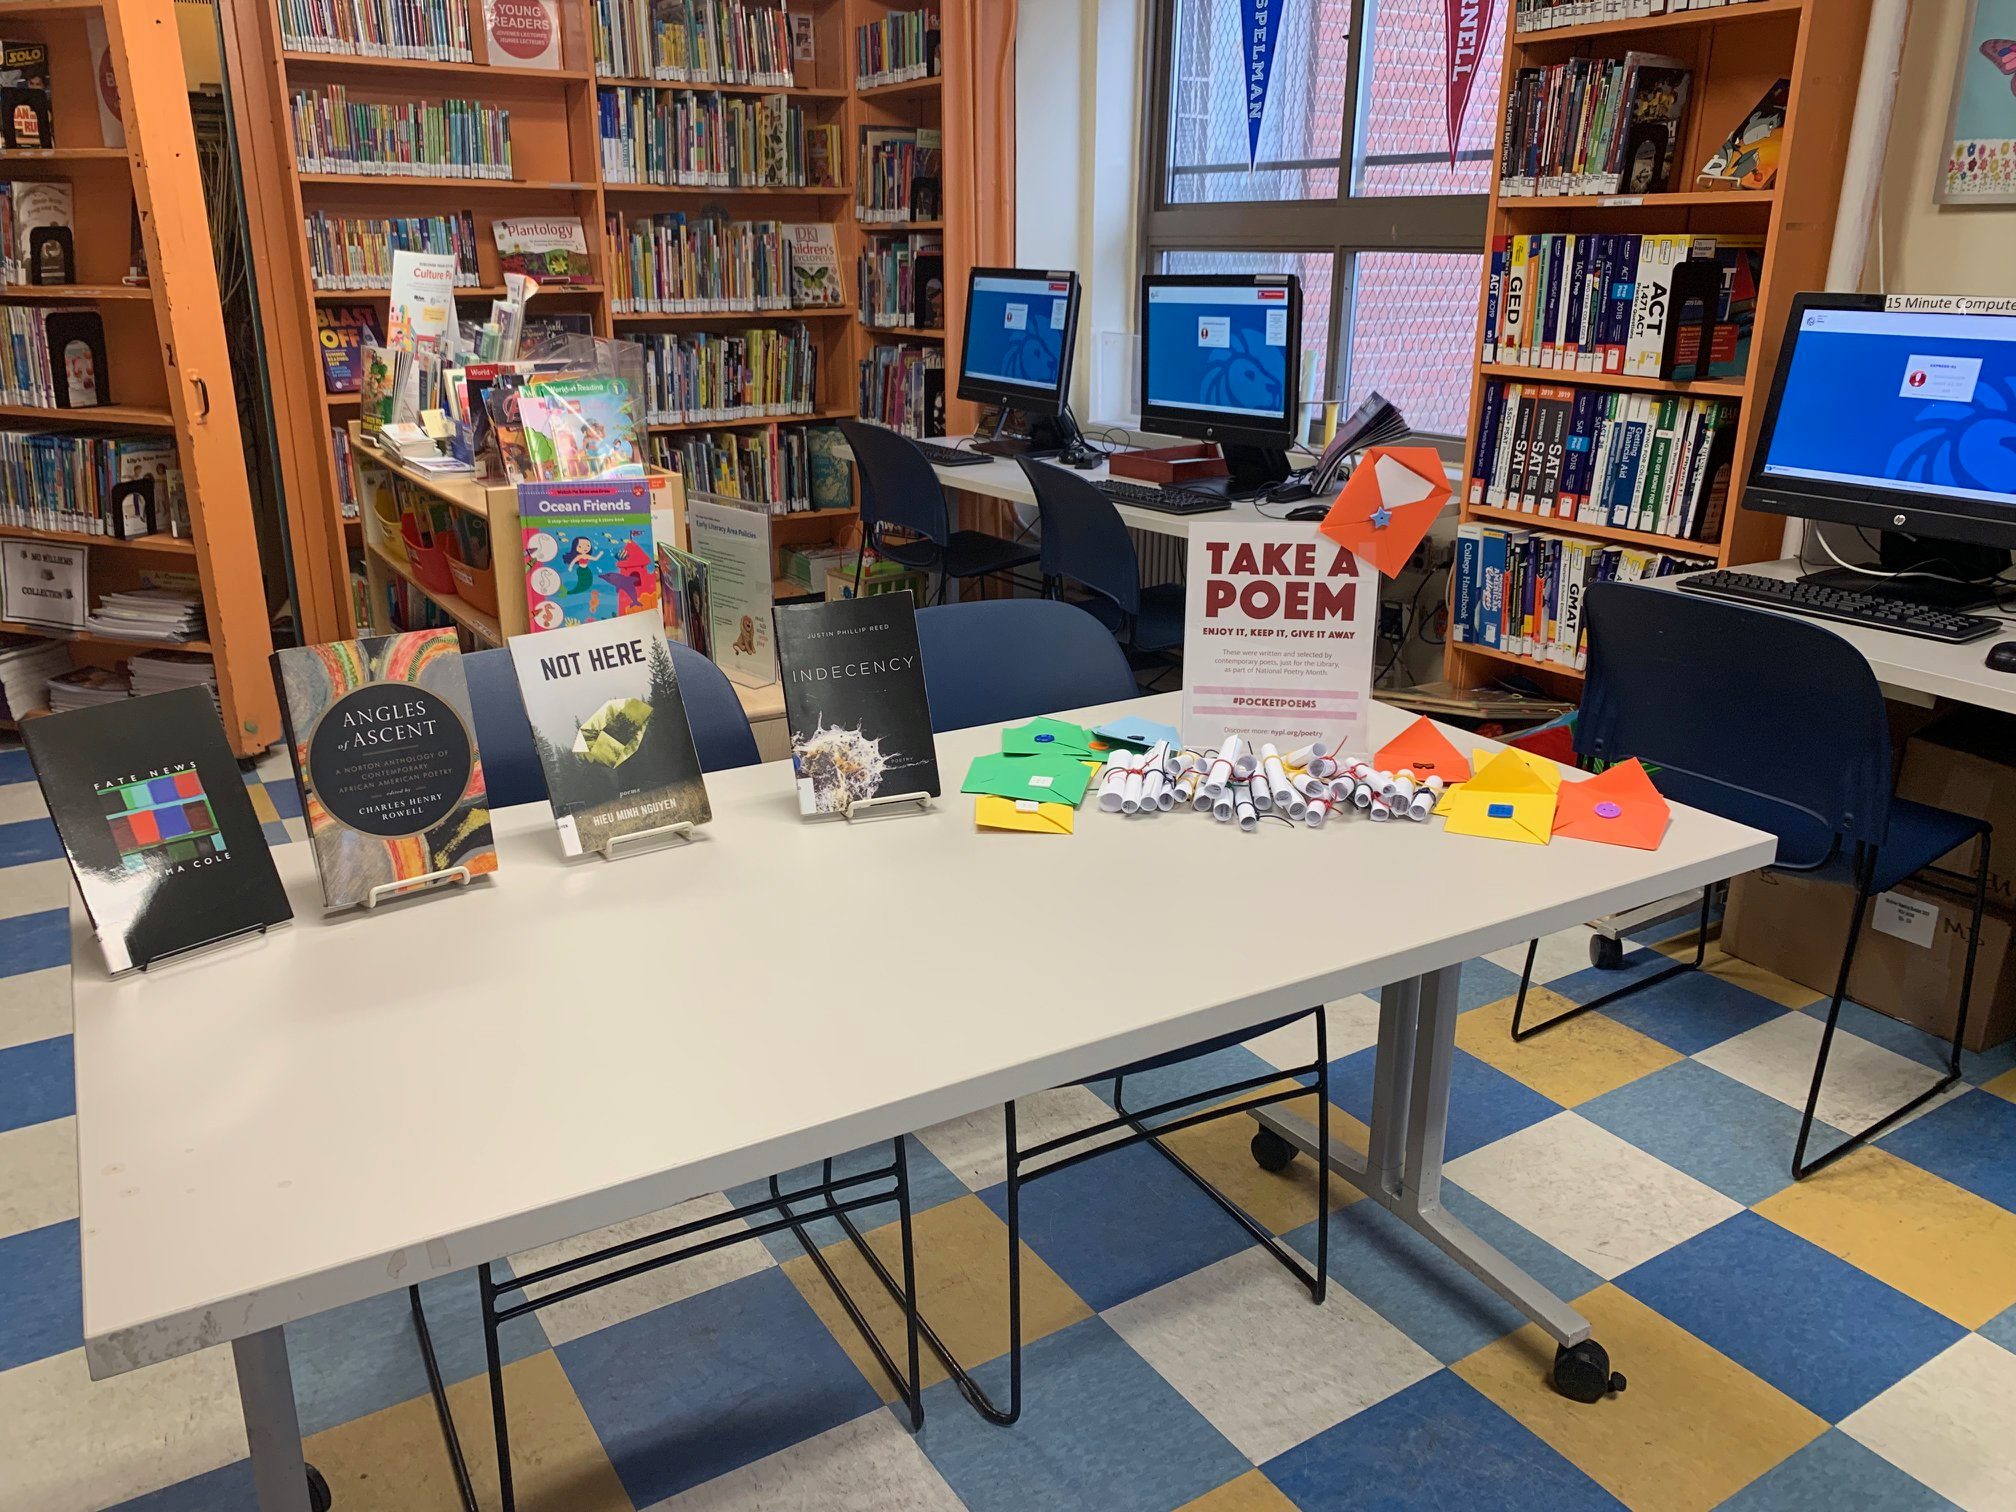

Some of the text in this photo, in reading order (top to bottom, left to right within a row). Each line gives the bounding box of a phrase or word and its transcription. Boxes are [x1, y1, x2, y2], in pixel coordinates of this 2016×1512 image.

[498, 4, 540, 16] YOUNG
[494, 17, 549, 30] READERS
[9, 49, 41, 62] SOLO
[1249, 0, 1268, 119] SPELMAN
[24, 122, 38, 133] RU
[1502, 131, 1511, 161] BATTLING
[508, 222, 573, 239] Plantology
[798, 227, 815, 241] DK
[794, 243, 834, 254] ildren's
[414, 268, 443, 279] Culture
[1575, 260, 1584, 280] TASC
[1621, 266, 1629, 281] ACT
[1490, 274, 1499, 296] ACT
[1573, 282, 1581, 296] Prep
[1508, 276, 1522, 324] GED
[1646, 281, 1667, 335] ACT
[1886, 297, 2016, 313] 15 Minute Compute
[1616, 301, 1624, 320] 2018
[1629, 282, 1641, 339] Practice Questions
[1636, 315, 1645, 337] ACT
[320, 329, 359, 348] OFF
[1576, 420, 1584, 434] SAT
[1593, 416, 1602, 430] SAT
[1513, 408, 1529, 473] PETERSON'S SAT
[1529, 409, 1546, 475] PETERSON'S SAT
[1546, 411, 1563, 479] PETERSON'S SAT
[1630, 427, 1643, 457] Getting
[1657, 442, 1665, 455] HOW
[1704, 435, 1710, 444] AP
[1569, 453, 1578, 470] 2018
[1618, 426, 1635, 479] Financial Aid
[1635, 425, 1653, 494] PAYING FOR COLLEGE
[1653, 464, 1661, 474] GET
[1670, 452, 1678, 475] Workout
[1680, 441, 1692, 487] AP Physics
[1602, 476, 1612, 500] Handbook
[1650, 474, 1659, 493] MONEY
[539, 499, 631, 512] Ocean Friends
[1648, 494, 1656, 504] FOR
[696, 520, 707, 530] Early
[709, 523, 726, 534] Literacy
[739, 530, 756, 539] Policies
[1206, 542, 1359, 577] TAKE A
[1460, 543, 1472, 619] College Handbook
[1483, 566, 1493, 610] Colleges
[1491, 568, 1499, 612] AMERICAN
[22, 587, 63, 600] COLLECTION
[1205, 580, 1357, 621] POEM
[1566, 583, 1579, 633] GMAT
[807, 624, 890, 639] JUSTIN PHILLIP REED
[1203, 628, 1355, 639] ENJOY IT, KEEP IT, GIVE IT AWAY
[540, 639, 647, 681] NOT HERE
[1215, 658, 1258, 666] contemporary
[1317, 661, 1340, 669] Library,
[1223, 649, 1241, 657] These
[1260, 650, 1282, 658] written
[1297, 651, 1323, 659] selected
[792, 655, 914, 683] INDECENCY
[1284, 668, 1304, 676] Poetry
[1233, 697, 1317, 709] #POCKETPOEMS
[343, 700, 427, 728] ANGLES
[337, 719, 437, 751] of ASCENT
[1224, 726, 1255, 734] Discover
[1271, 728, 1323, 737] nypl.org/poetry
[344, 761, 381, 774] NORTON
[384, 753, 436, 766] ANTHOLOGY
[438, 750, 449, 758] OF
[94, 761, 197, 792] FATE NEWS
[339, 768, 453, 794] AFRICAN AMERICAN POETRY
[361, 763, 429, 781] CONTEMPORARY
[619, 788, 641, 798] poems
[358, 793, 443, 815] CHARLES HENRY
[593, 798, 677, 827] HIEU MINH NGUYEN
[382, 807, 424, 821] ROWELL
[193, 852, 232, 869] COLE
